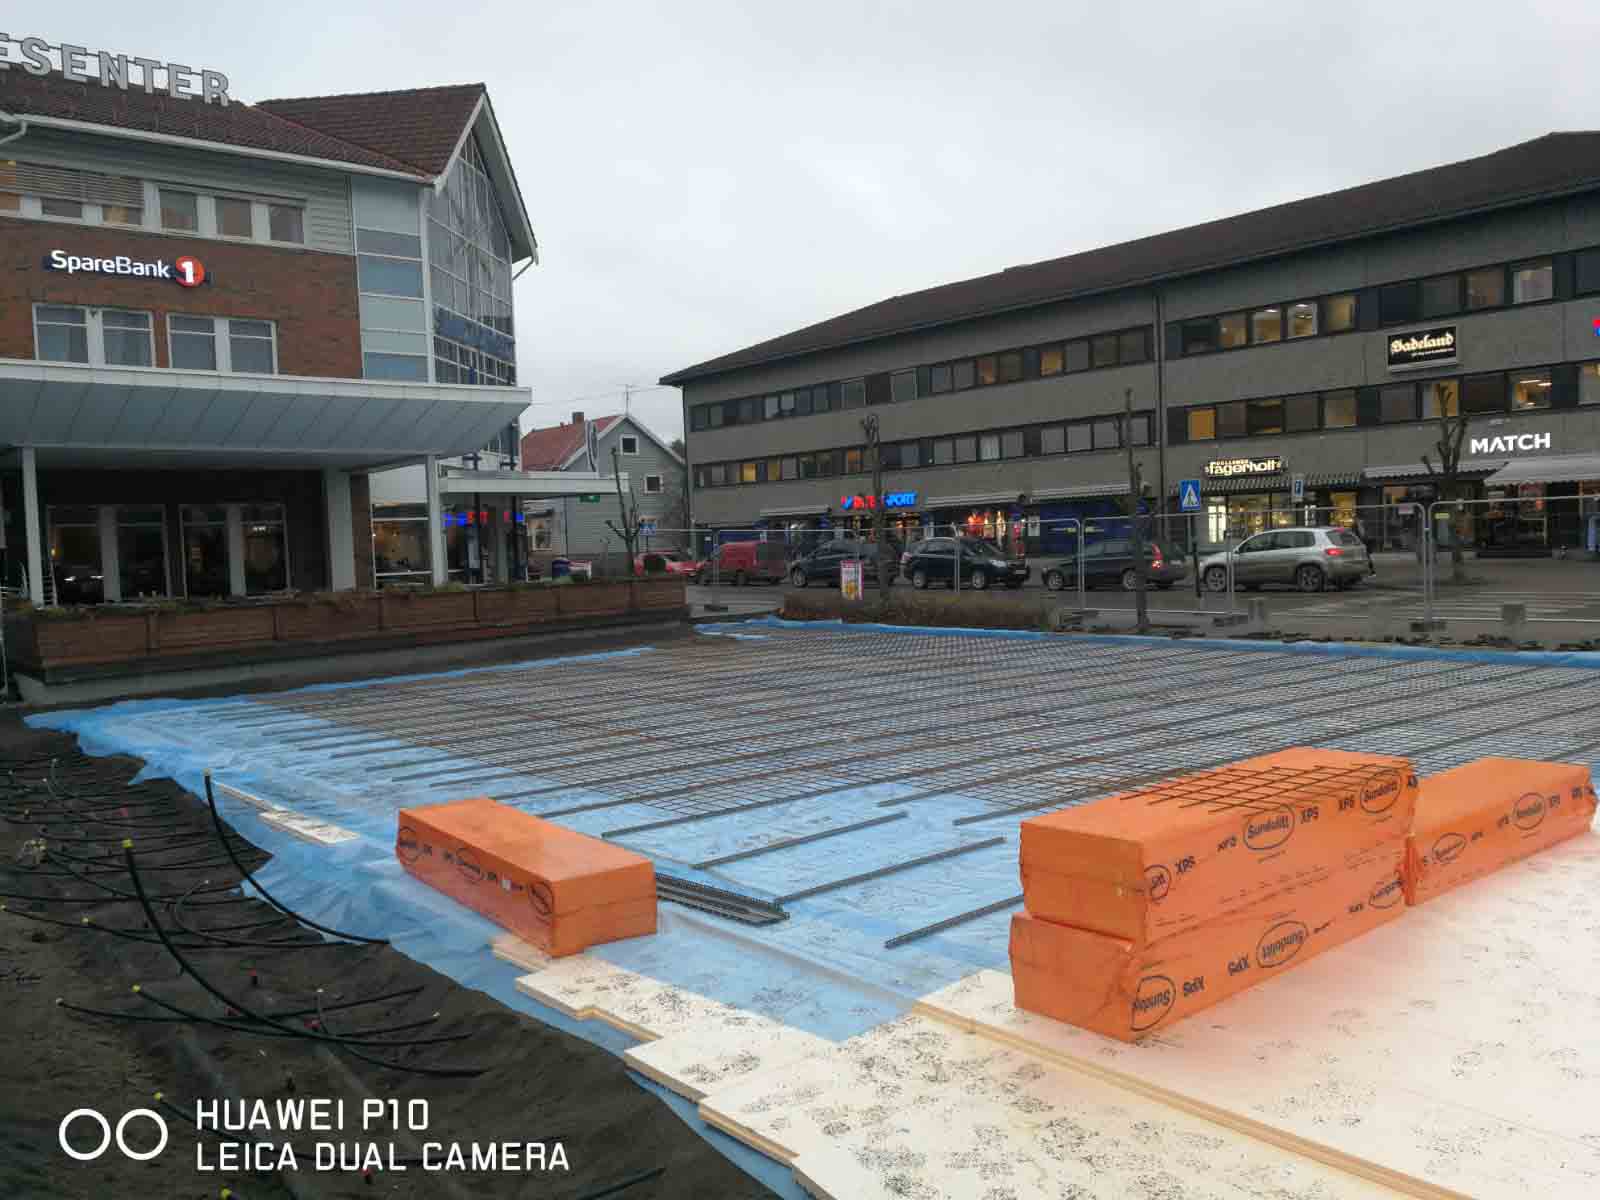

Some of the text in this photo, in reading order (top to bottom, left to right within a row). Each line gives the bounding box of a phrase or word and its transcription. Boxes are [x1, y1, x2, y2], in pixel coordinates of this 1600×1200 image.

[51, 250, 195, 284] SpareBank 1
[1391, 331, 1454, 354] Badeland
[1471, 432, 1551, 454] MATCH
[1299, 806, 1320, 824] XPS
[1175, 855, 1196, 874] XPS
[1183, 976, 1205, 997] XPS
